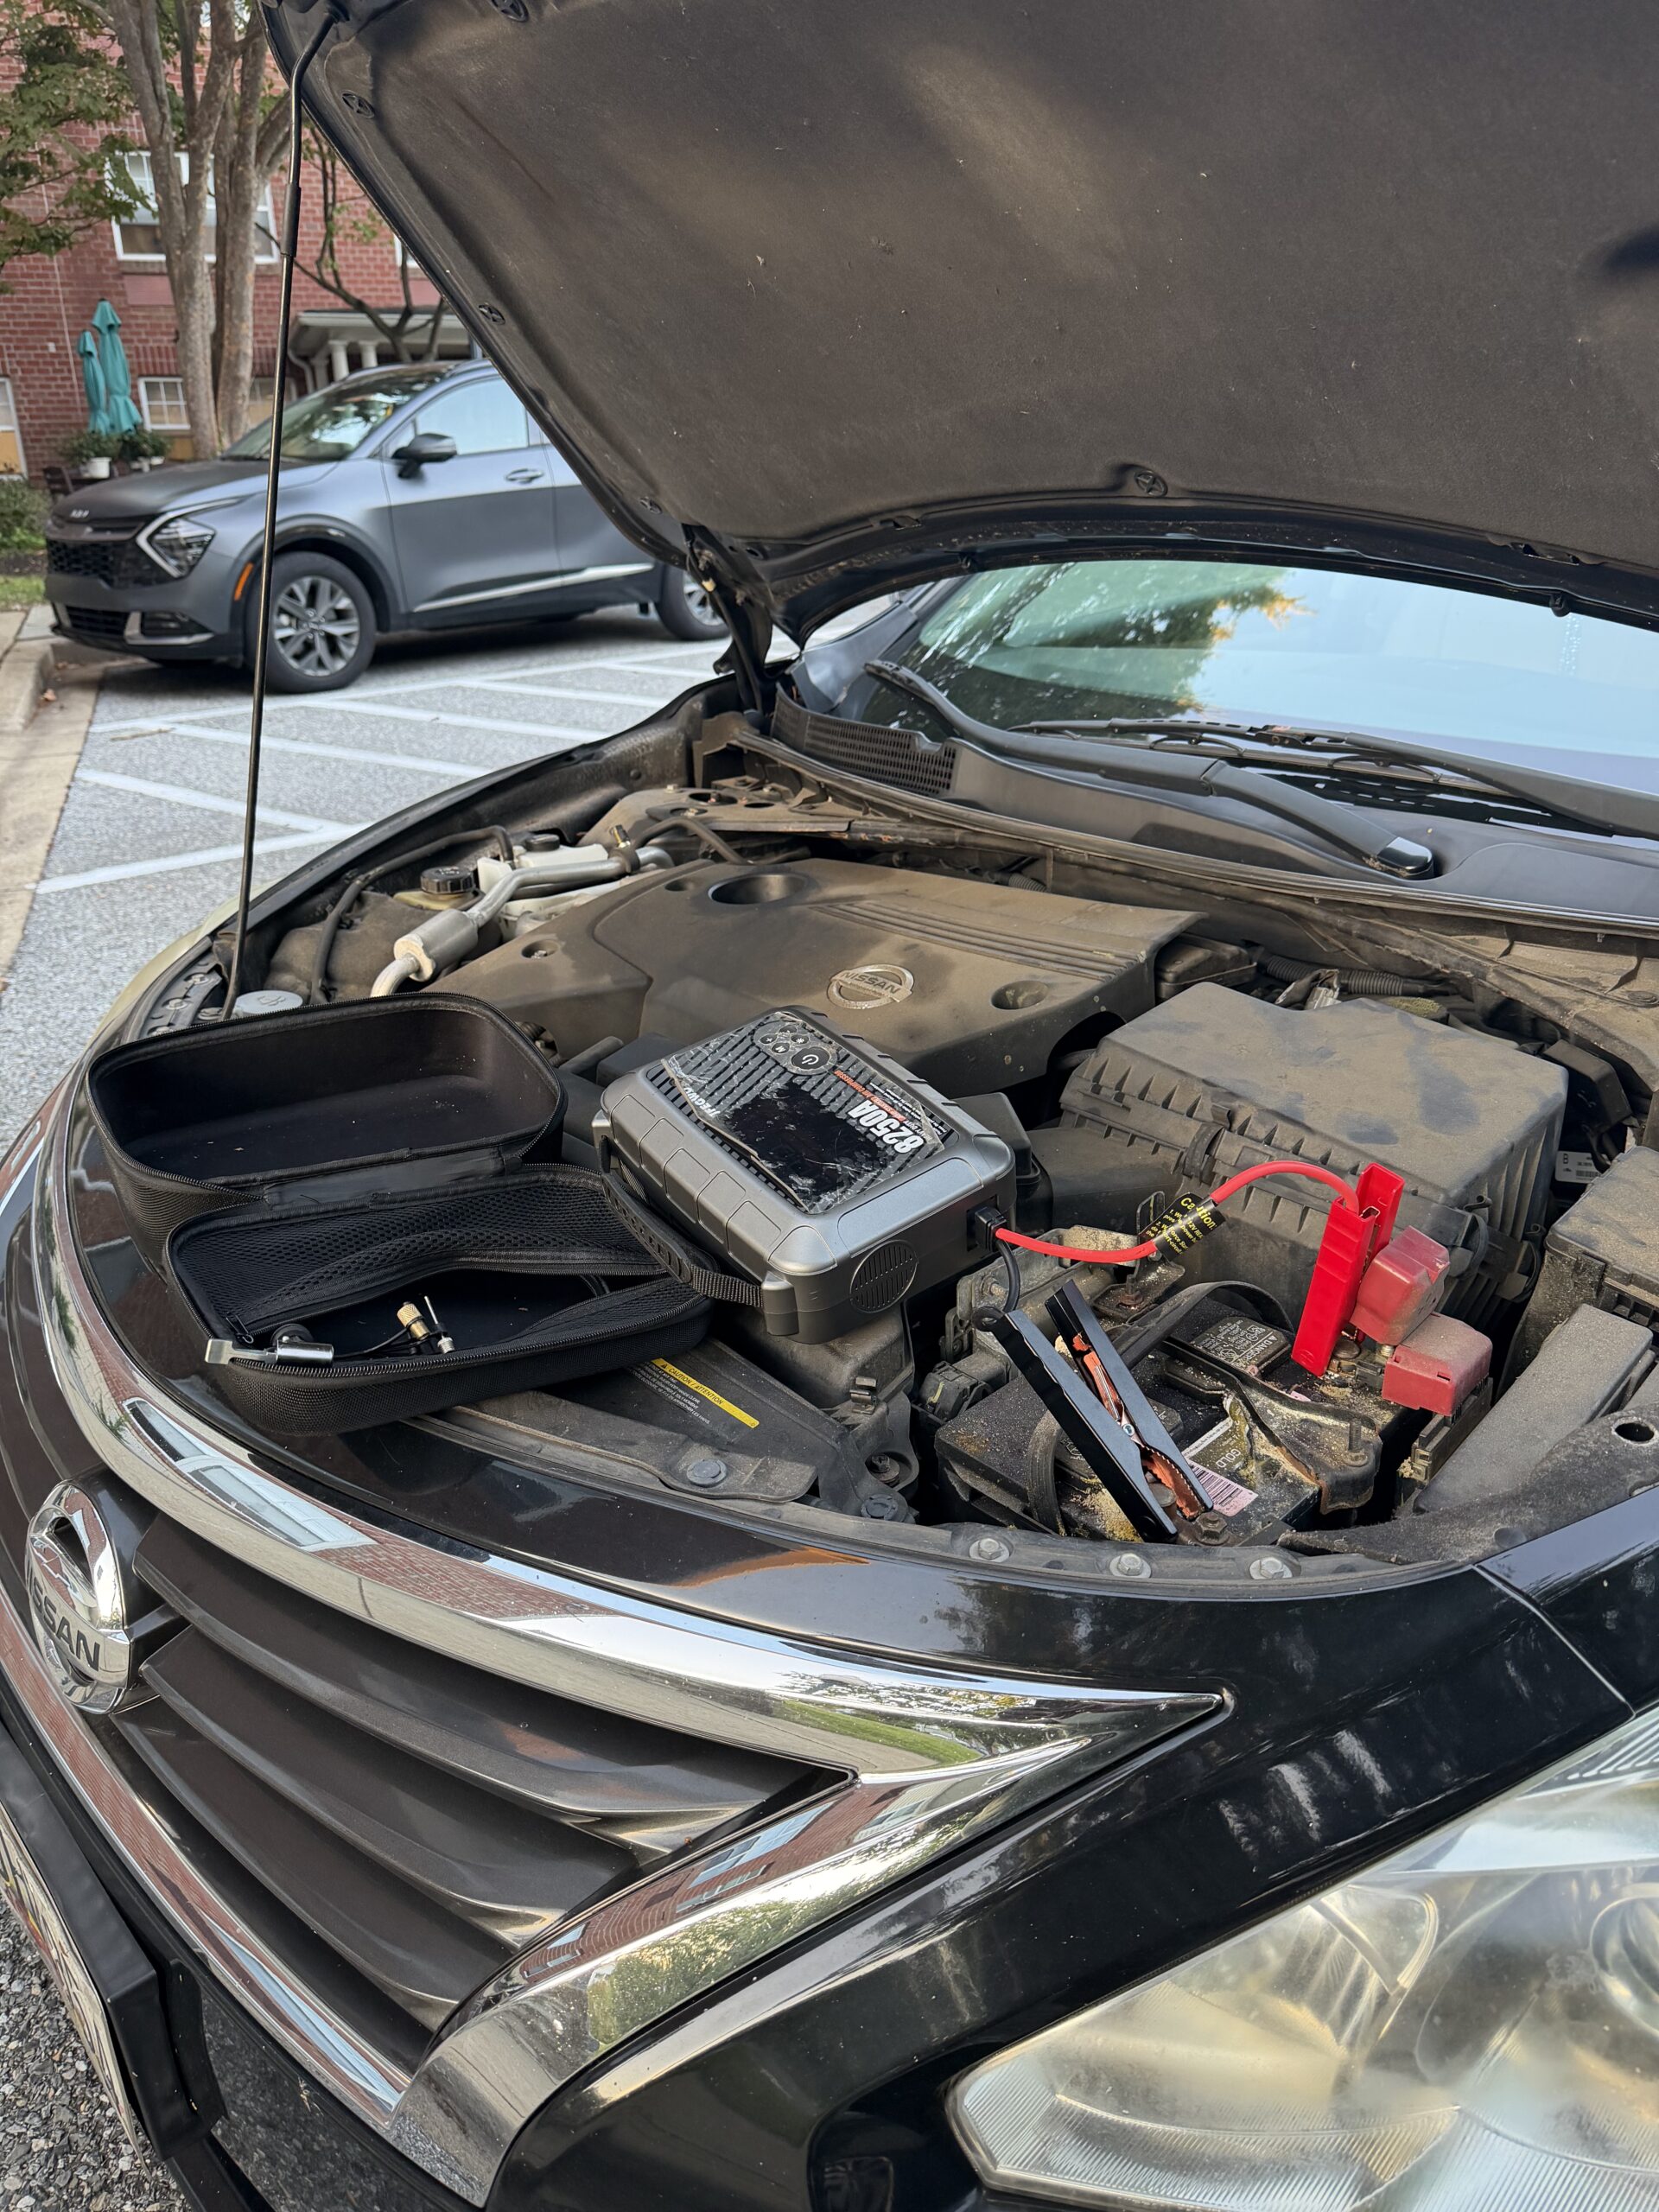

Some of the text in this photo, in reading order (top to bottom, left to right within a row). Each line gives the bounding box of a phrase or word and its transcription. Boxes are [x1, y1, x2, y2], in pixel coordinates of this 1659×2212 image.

[840, 971, 902, 995] NISSAN
[833, 1067, 865, 1092] COMPRESSOR
[847, 1096, 925, 1156] 8250A
[902, 1117, 918, 1130] DUTY
[914, 1126, 932, 1141] HEAVY
[1162, 1213, 1175, 1224] pres
[1243, 1338, 1272, 1361] DANGER
[668, 1367, 692, 1384] CAUTION
[693, 1384, 724, 1405] ATTENTION
[1215, 1447, 1241, 1467] GOLD
